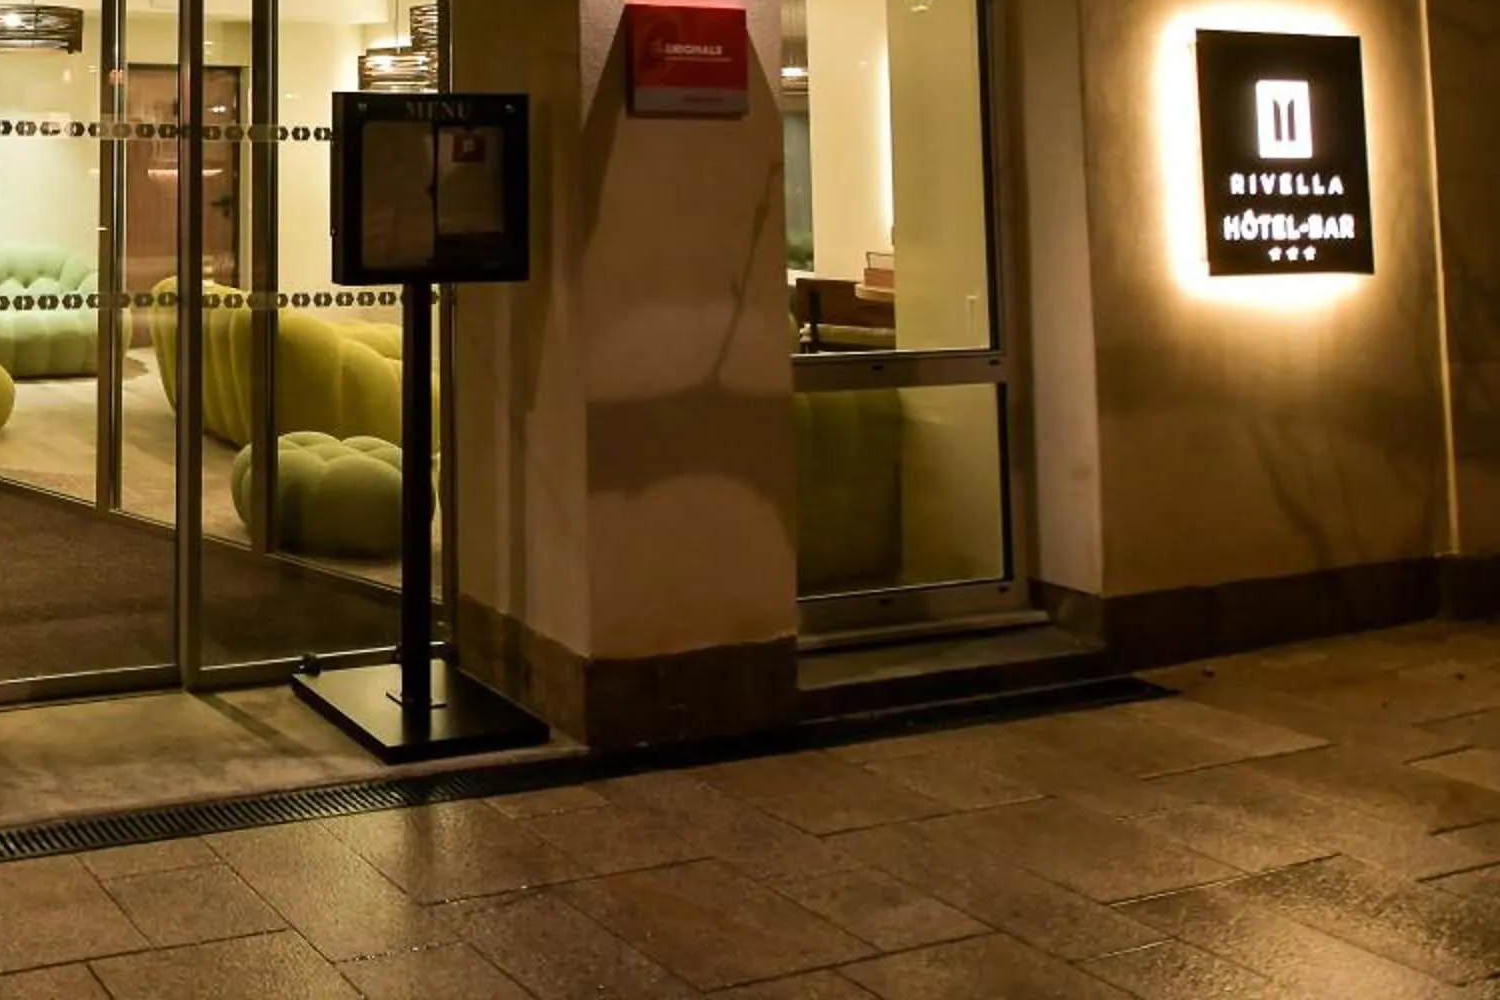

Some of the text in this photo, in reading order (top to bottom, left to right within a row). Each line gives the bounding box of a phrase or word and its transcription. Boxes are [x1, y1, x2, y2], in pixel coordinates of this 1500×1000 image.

[404, 100, 473, 121] MENU
[1229, 172, 1345, 195] RIVELLA
[1222, 208, 1356, 241] HÔTEL-BAR
